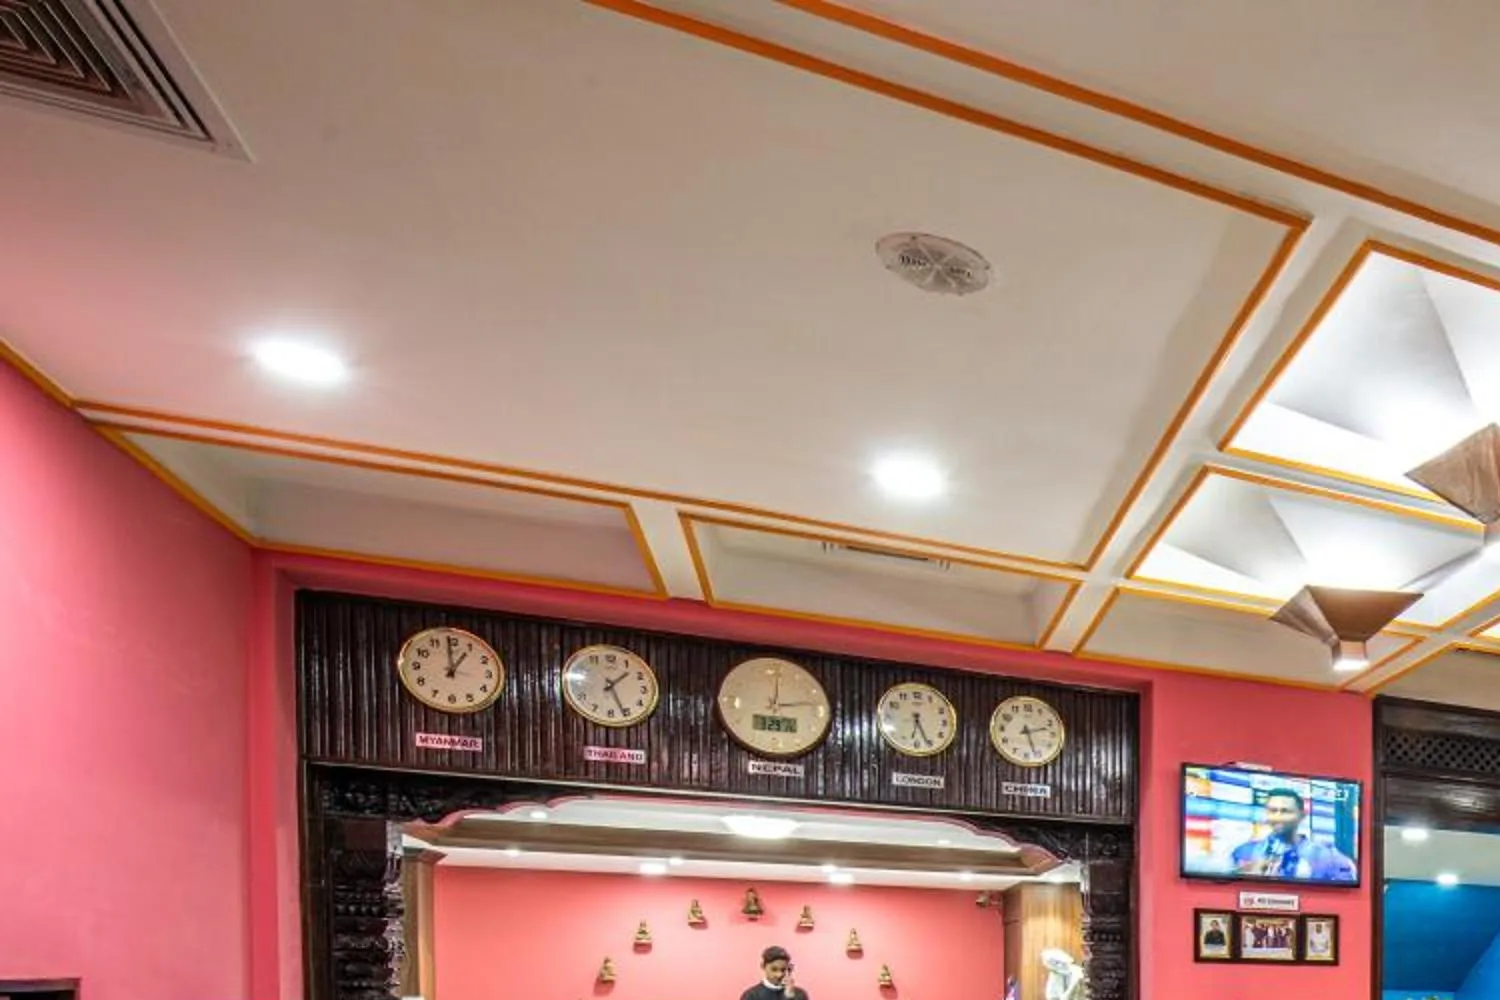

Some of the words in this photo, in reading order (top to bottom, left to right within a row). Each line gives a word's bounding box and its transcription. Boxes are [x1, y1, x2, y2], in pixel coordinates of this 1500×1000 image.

[419, 735, 480, 748] MYANMAR
[586, 749, 643, 761] THAILAND
[751, 763, 800, 774] NEPAL
[895, 774, 941, 786] LONDON
[1004, 785, 1047, 795] CHINA
